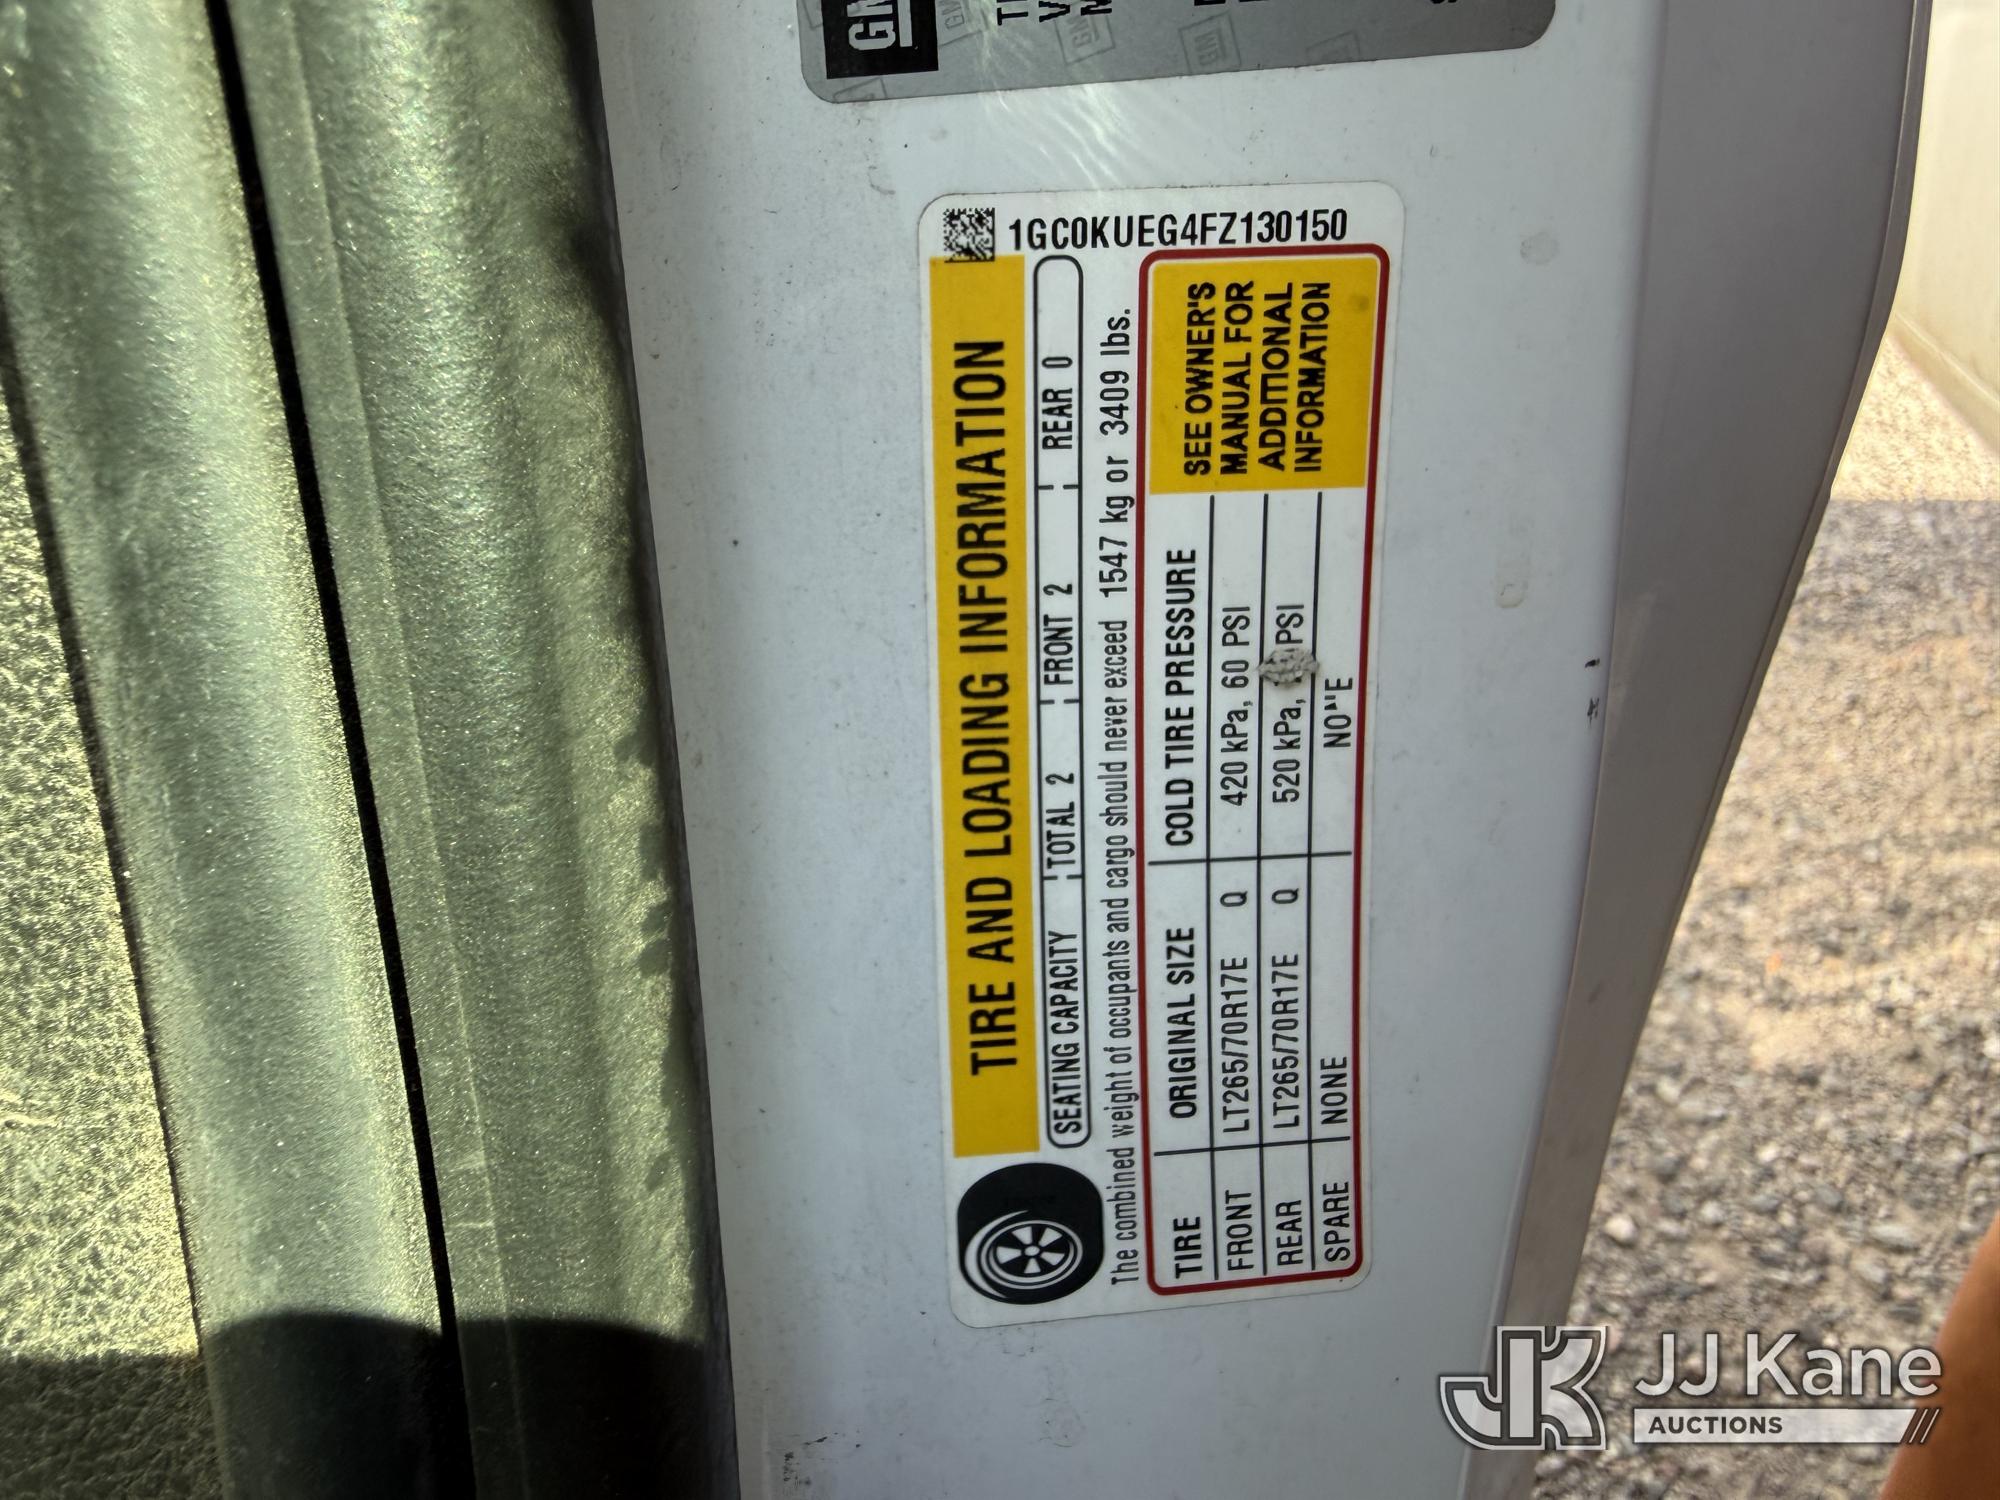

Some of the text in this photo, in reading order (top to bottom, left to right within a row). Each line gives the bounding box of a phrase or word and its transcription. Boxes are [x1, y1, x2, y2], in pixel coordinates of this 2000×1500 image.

[1009, 208, 1347, 250] 1GC0KUEG4FZ130150
[1041, 356, 1073, 450] REAR 0
[1184, 282, 1216, 476] SEE OWNER'S
[1219, 280, 1255, 475] MANUAL FOR
[1258, 283, 1294, 471] ADDITIONAL
[1294, 283, 1331, 472] INFORMATION
[1045, 584, 1073, 686] FRONT 2
[1275, 604, 1305, 644] PSI
[954, 341, 1017, 1075] TIRE AND LOADING INFORMATION
[1165, 549, 1196, 846] COLD TIRE PRESSURE
[1219, 606, 1253, 806] 420 kPa, 60 PSI
[1273, 698, 1306, 752] kPa,
[1046, 773, 1075, 869] TOTAL 2
[1098, 308, 1140, 1285] The combined weight of occupants and cargo should never exceed 1547 kg or 3409 lbs.
[1272, 759, 1301, 803] 520
[1220, 891, 1248, 908] Q
[1271, 888, 1299, 905] Q
[1048, 931, 1081, 1134] SEATING CAPACITY
[1166, 928, 1198, 1118] ORIGINAL SIZE
[1220, 957, 1250, 1133] LT265/70R17E
[1271, 954, 1300, 1129] LT265/70R17E
[1320, 1056, 1348, 1125] NONE
[1173, 1216, 1202, 1279] TIRE
[1225, 1191, 1253, 1271] FRONT
[1275, 1200, 1304, 1266] REAR
[1323, 1181, 1350, 1262] SPARE
